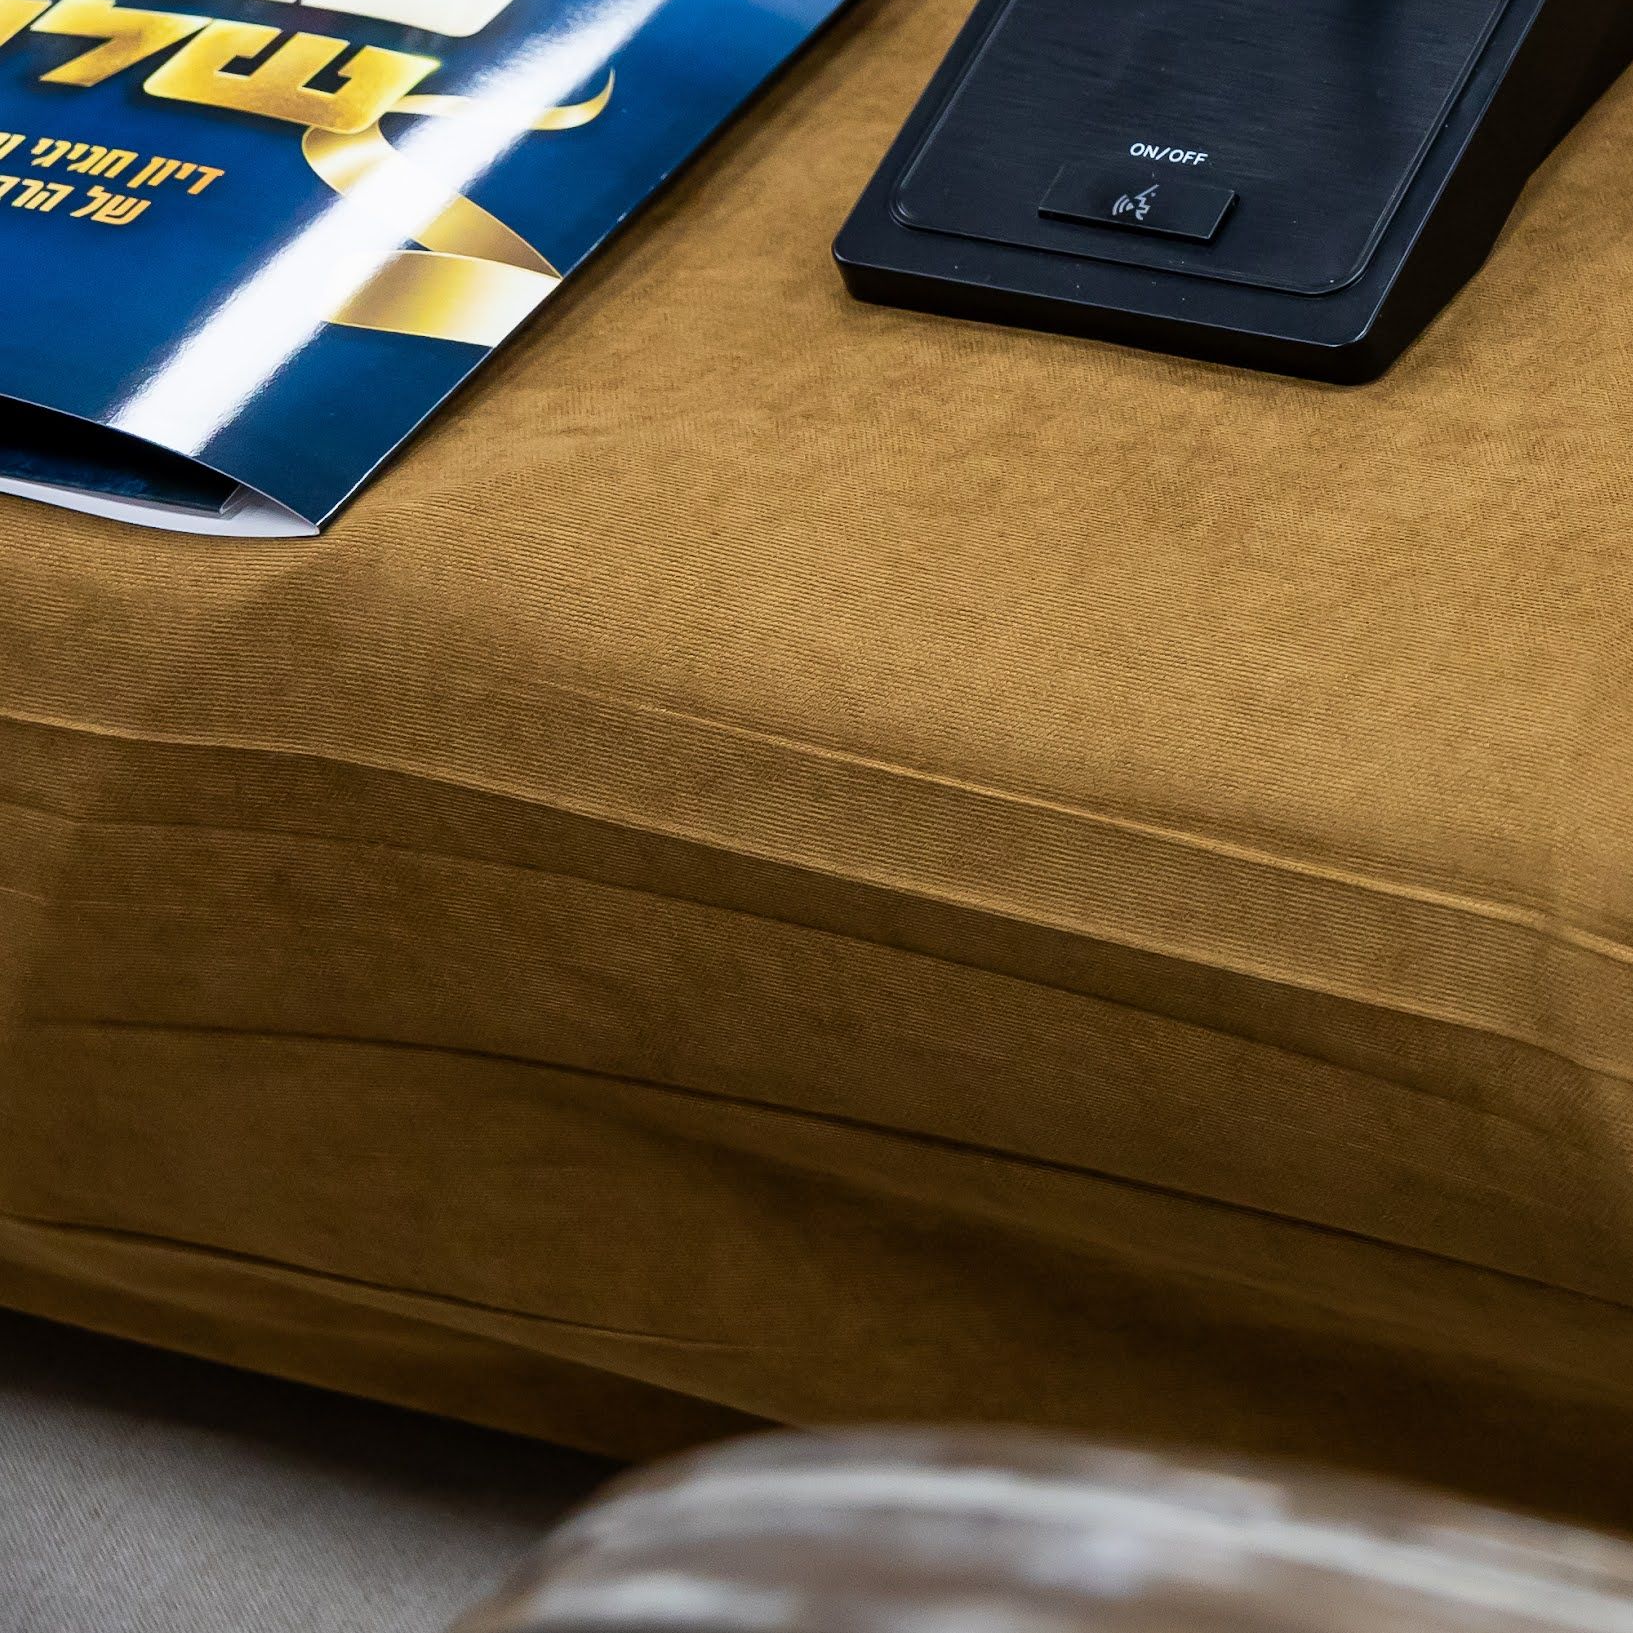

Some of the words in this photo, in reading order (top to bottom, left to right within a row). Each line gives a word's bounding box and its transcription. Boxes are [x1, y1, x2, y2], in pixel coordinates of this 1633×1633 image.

[30, 137, 140, 180] חגיגי
[1129, 142, 1209, 166] ON/OFF
[126, 155, 226, 196] דיון
[69, 185, 152, 226] של
